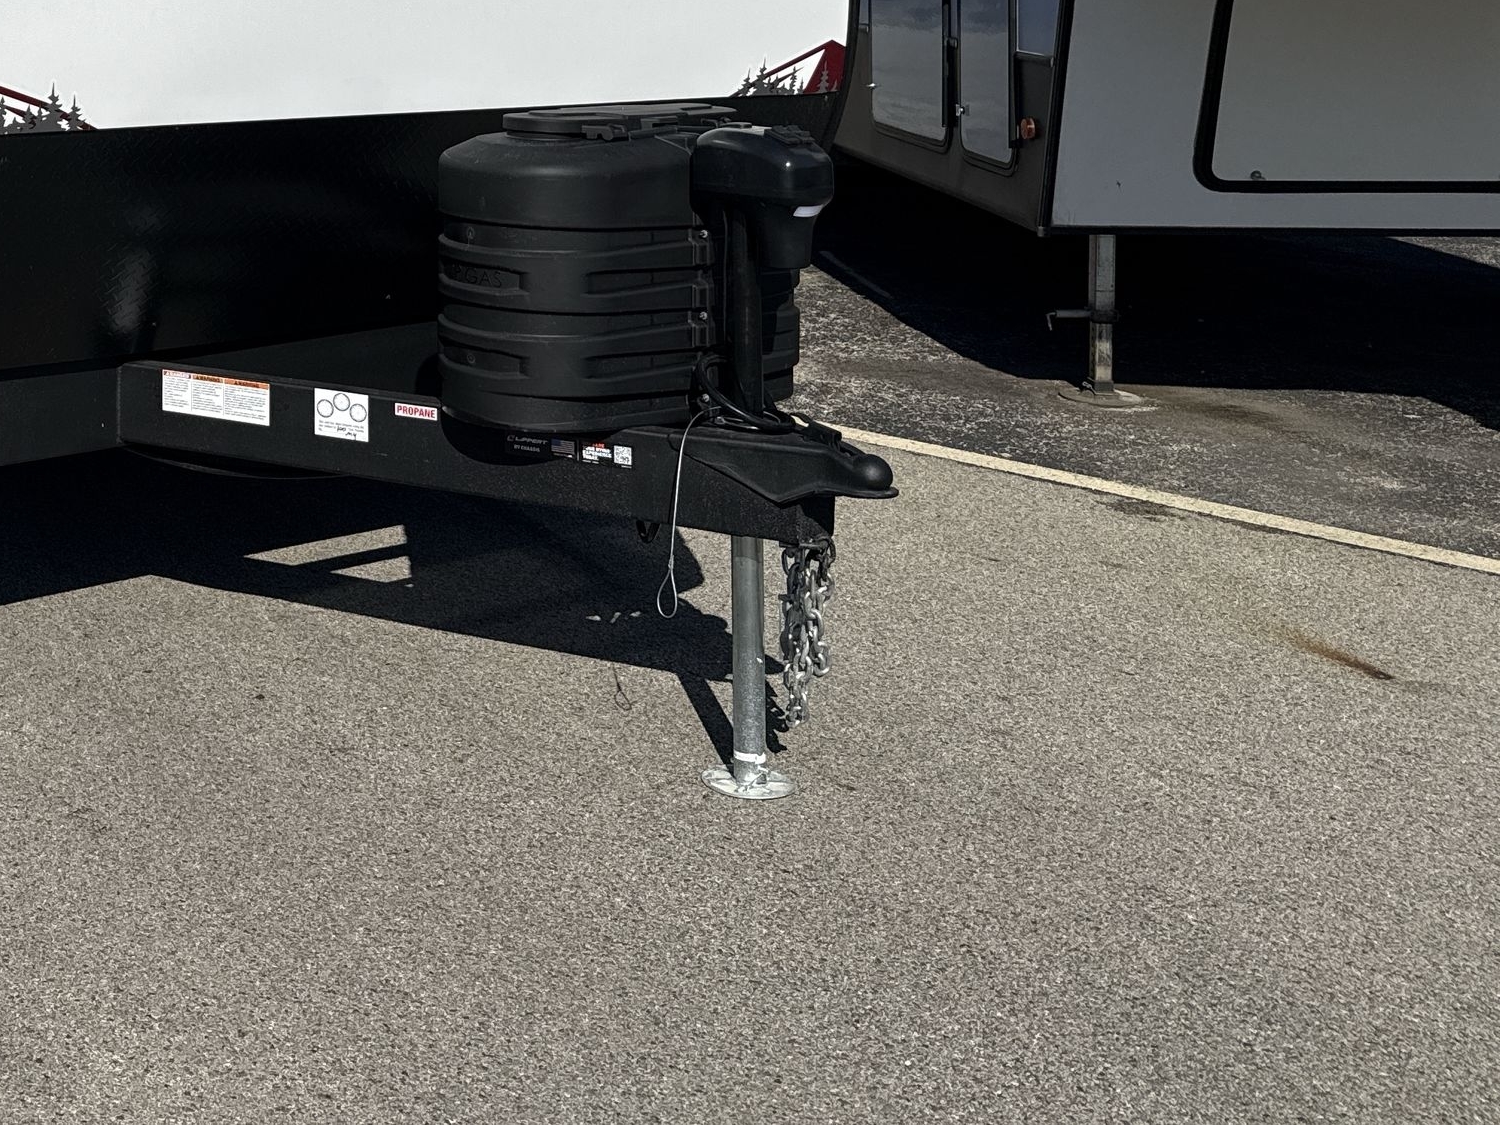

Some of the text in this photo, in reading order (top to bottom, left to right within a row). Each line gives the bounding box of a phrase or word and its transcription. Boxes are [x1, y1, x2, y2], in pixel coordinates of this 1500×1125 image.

[465, 266, 502, 288] GAS
[397, 405, 435, 418] PROPANE
[515, 436, 548, 445] LIPPERT
